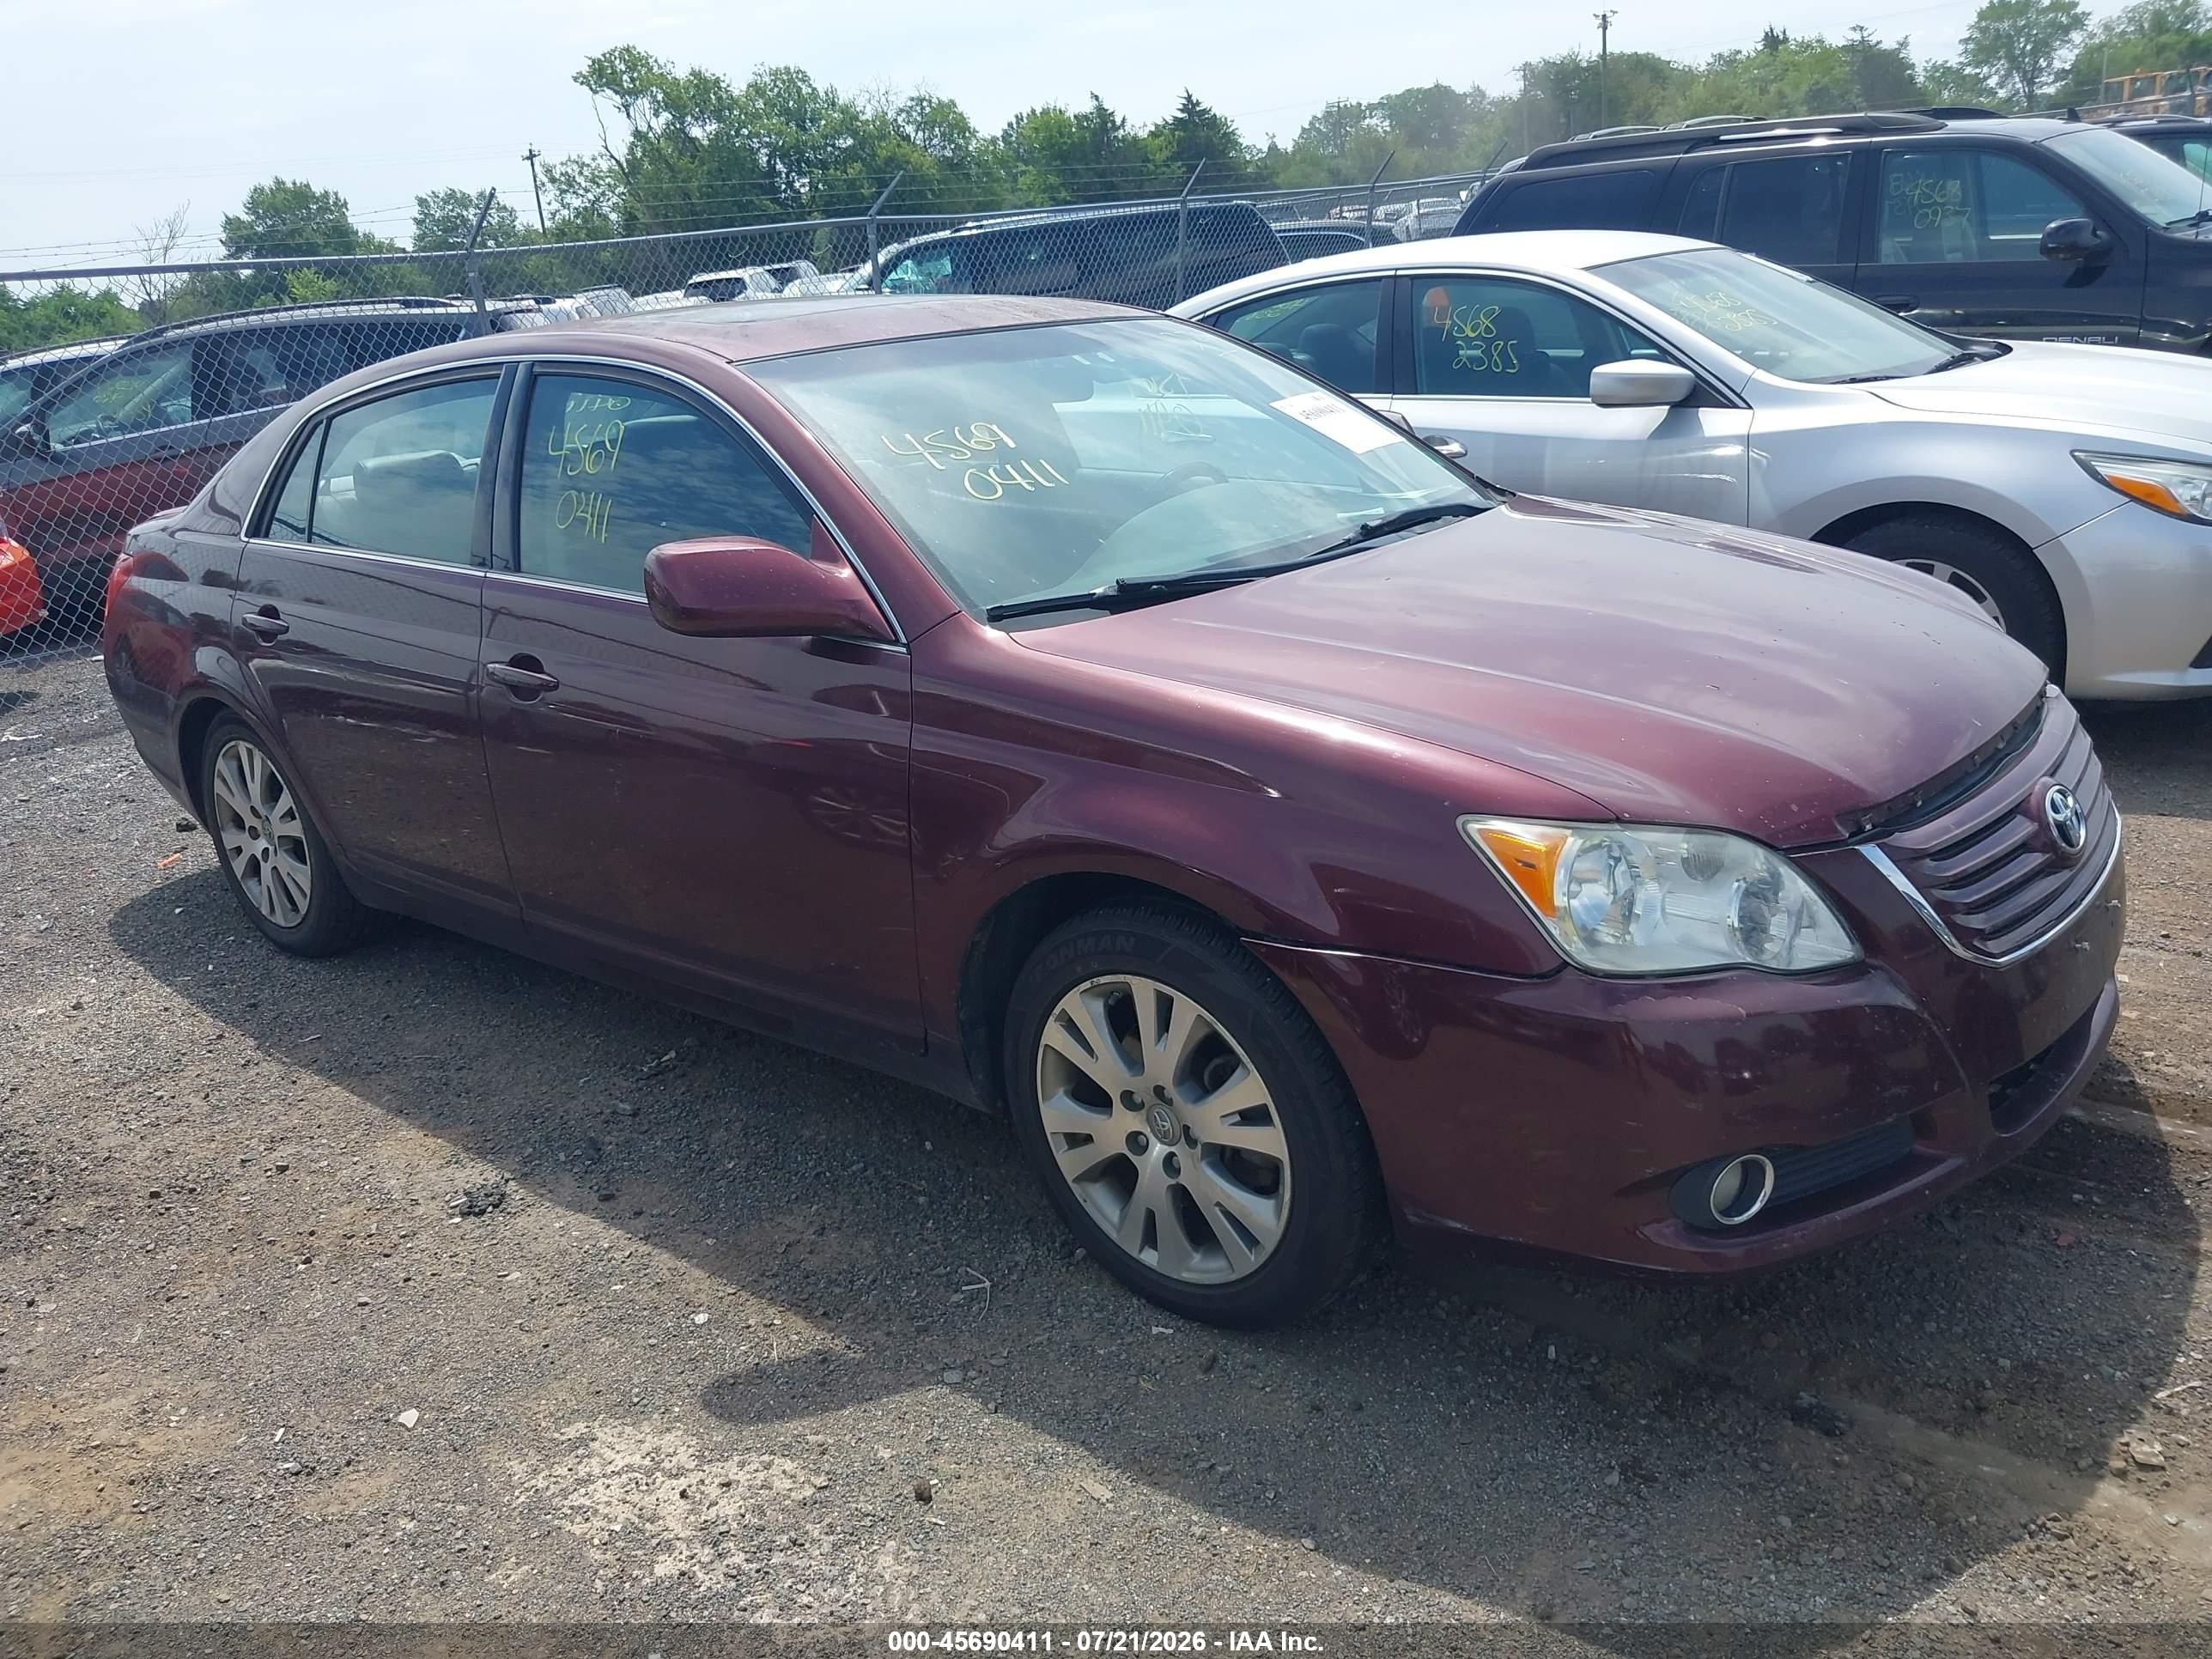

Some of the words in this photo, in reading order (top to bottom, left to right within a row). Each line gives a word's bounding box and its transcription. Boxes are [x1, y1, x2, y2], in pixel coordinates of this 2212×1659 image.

[1434, 304, 1502, 342] 4568
[2042, 336, 2118, 344] DENALI
[1452, 340, 1519, 373] 2385
[548, 419, 626, 480] 4569
[881, 422, 1017, 470] 4569
[963, 459, 1069, 500] 0411
[556, 489, 612, 544] 0411
